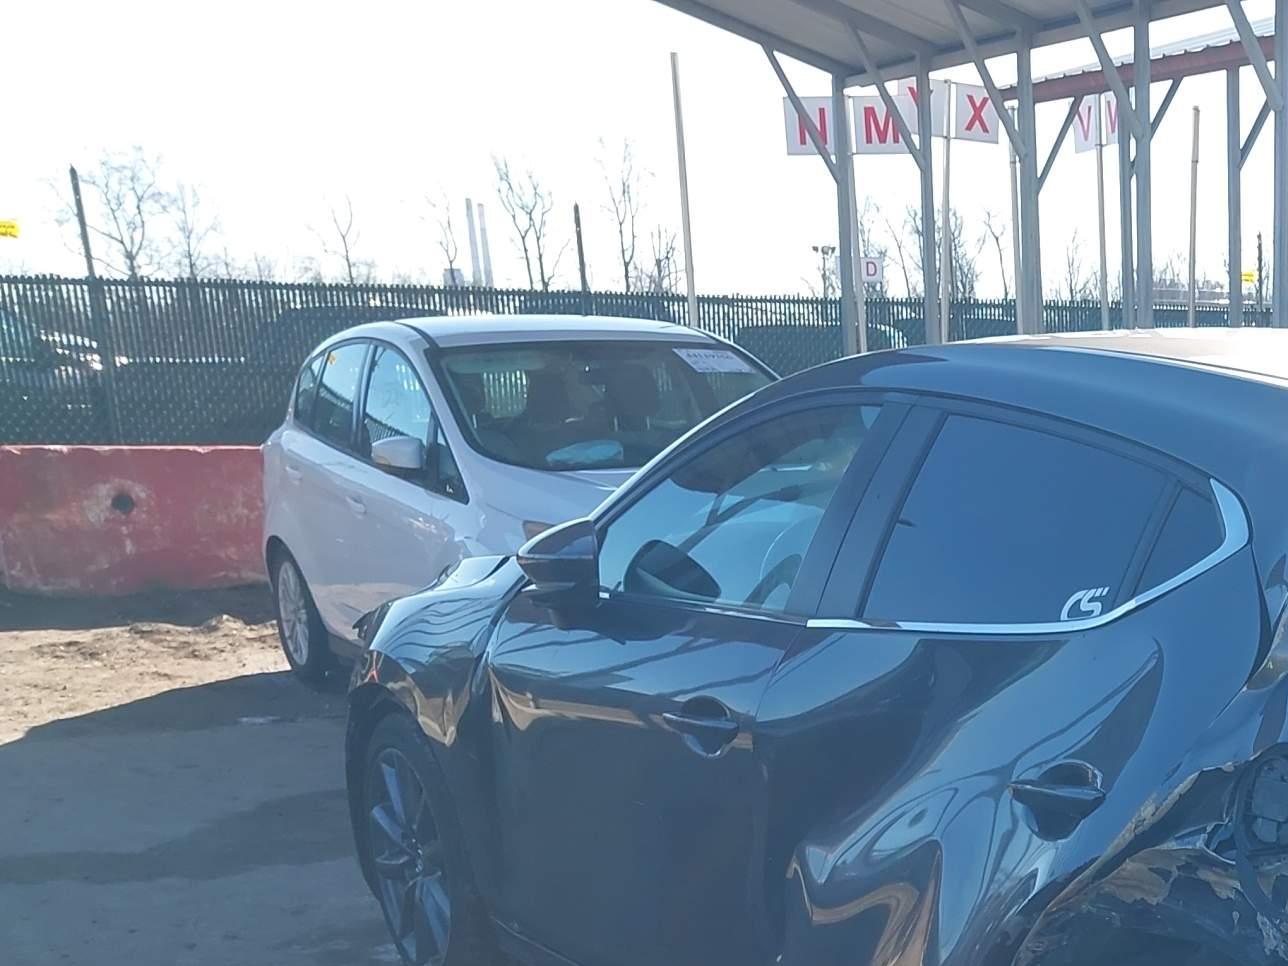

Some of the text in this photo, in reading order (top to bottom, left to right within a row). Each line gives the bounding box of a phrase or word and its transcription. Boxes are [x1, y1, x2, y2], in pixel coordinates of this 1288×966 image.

[798, 107, 828, 146] N
[863, 106, 900, 145] M
[964, 94, 990, 134] X
[866, 261, 877, 277] D
